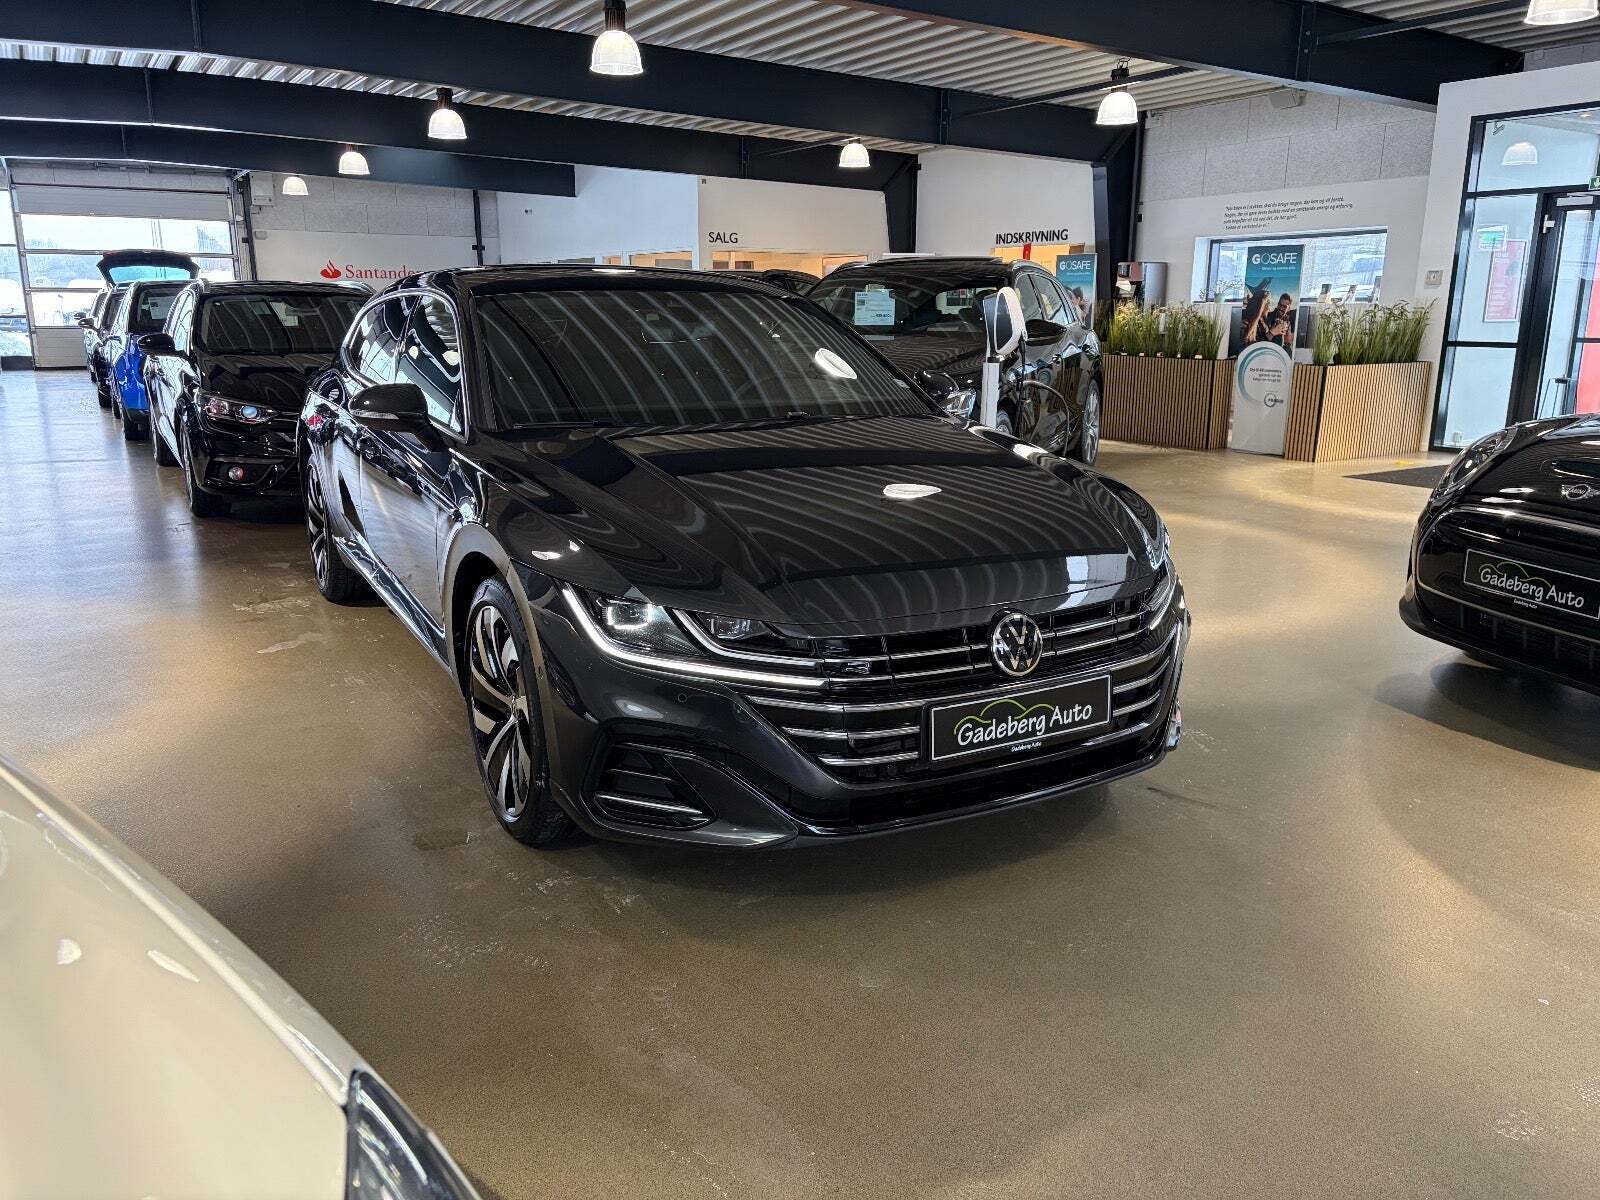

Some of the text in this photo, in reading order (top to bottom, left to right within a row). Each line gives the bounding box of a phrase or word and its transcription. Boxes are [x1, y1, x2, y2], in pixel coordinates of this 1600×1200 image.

[708, 231, 738, 244] SALG
[995, 229, 1069, 245] INDSKRIVNING
[1059, 260, 1091, 271] GOSAFE
[1251, 252, 1298, 265] GOSAFE
[1480, 568, 1585, 608] Gadeberg Auto
[957, 703, 1093, 746] Gadeberg Auto
